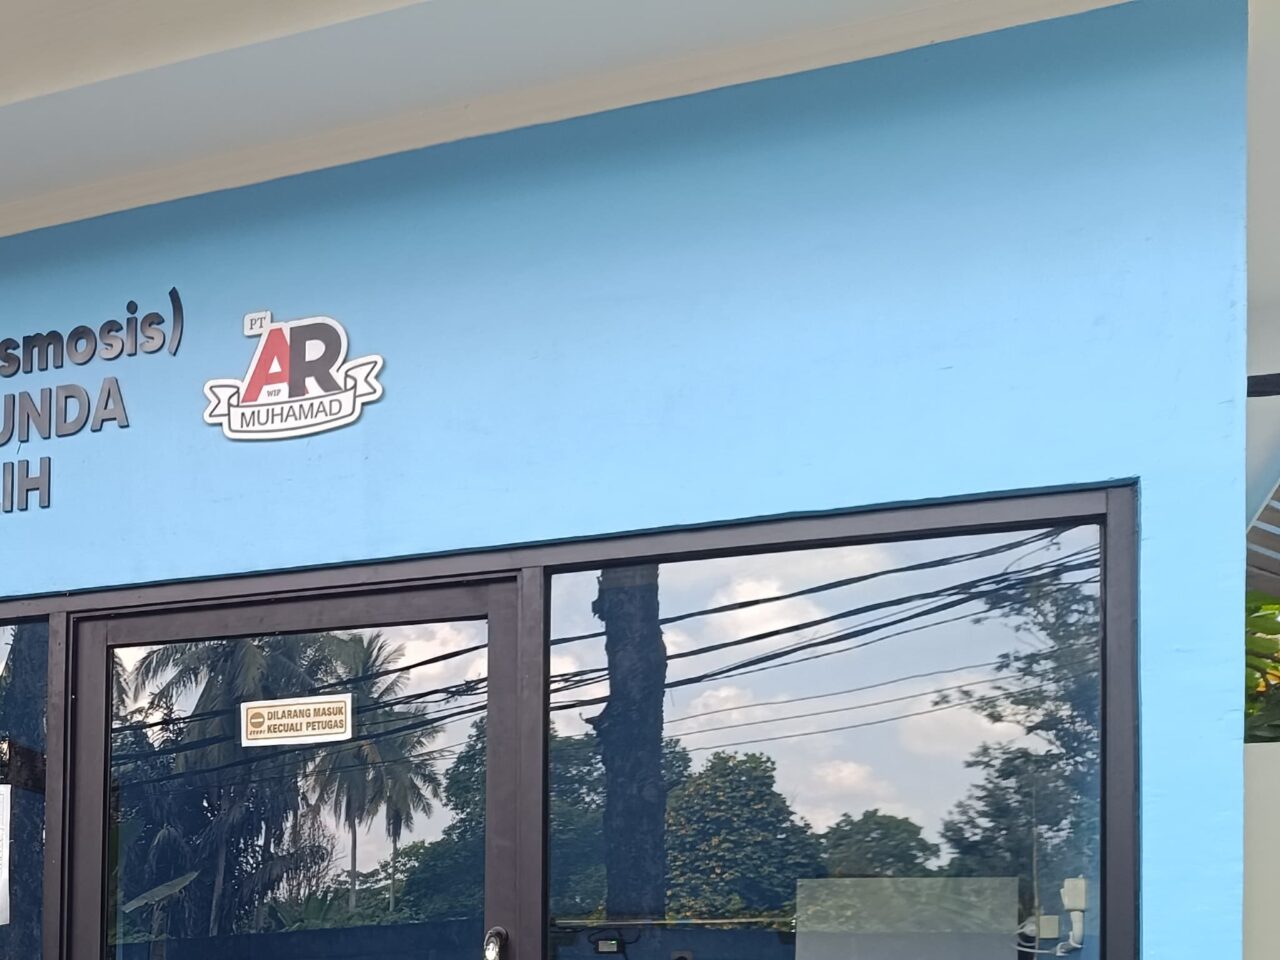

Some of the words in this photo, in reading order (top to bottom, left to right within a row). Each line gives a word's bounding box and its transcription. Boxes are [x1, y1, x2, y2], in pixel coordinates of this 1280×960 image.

[249, 316, 267, 330] PT
[241, 322, 343, 403] AR
[240, 399, 342, 428] MUHAMAD
[267, 708, 311, 721] DILARANG
[313, 706, 344, 717] MASUK
[267, 723, 303, 734] KECUALI
[306, 719, 344, 731] PETUGAS
